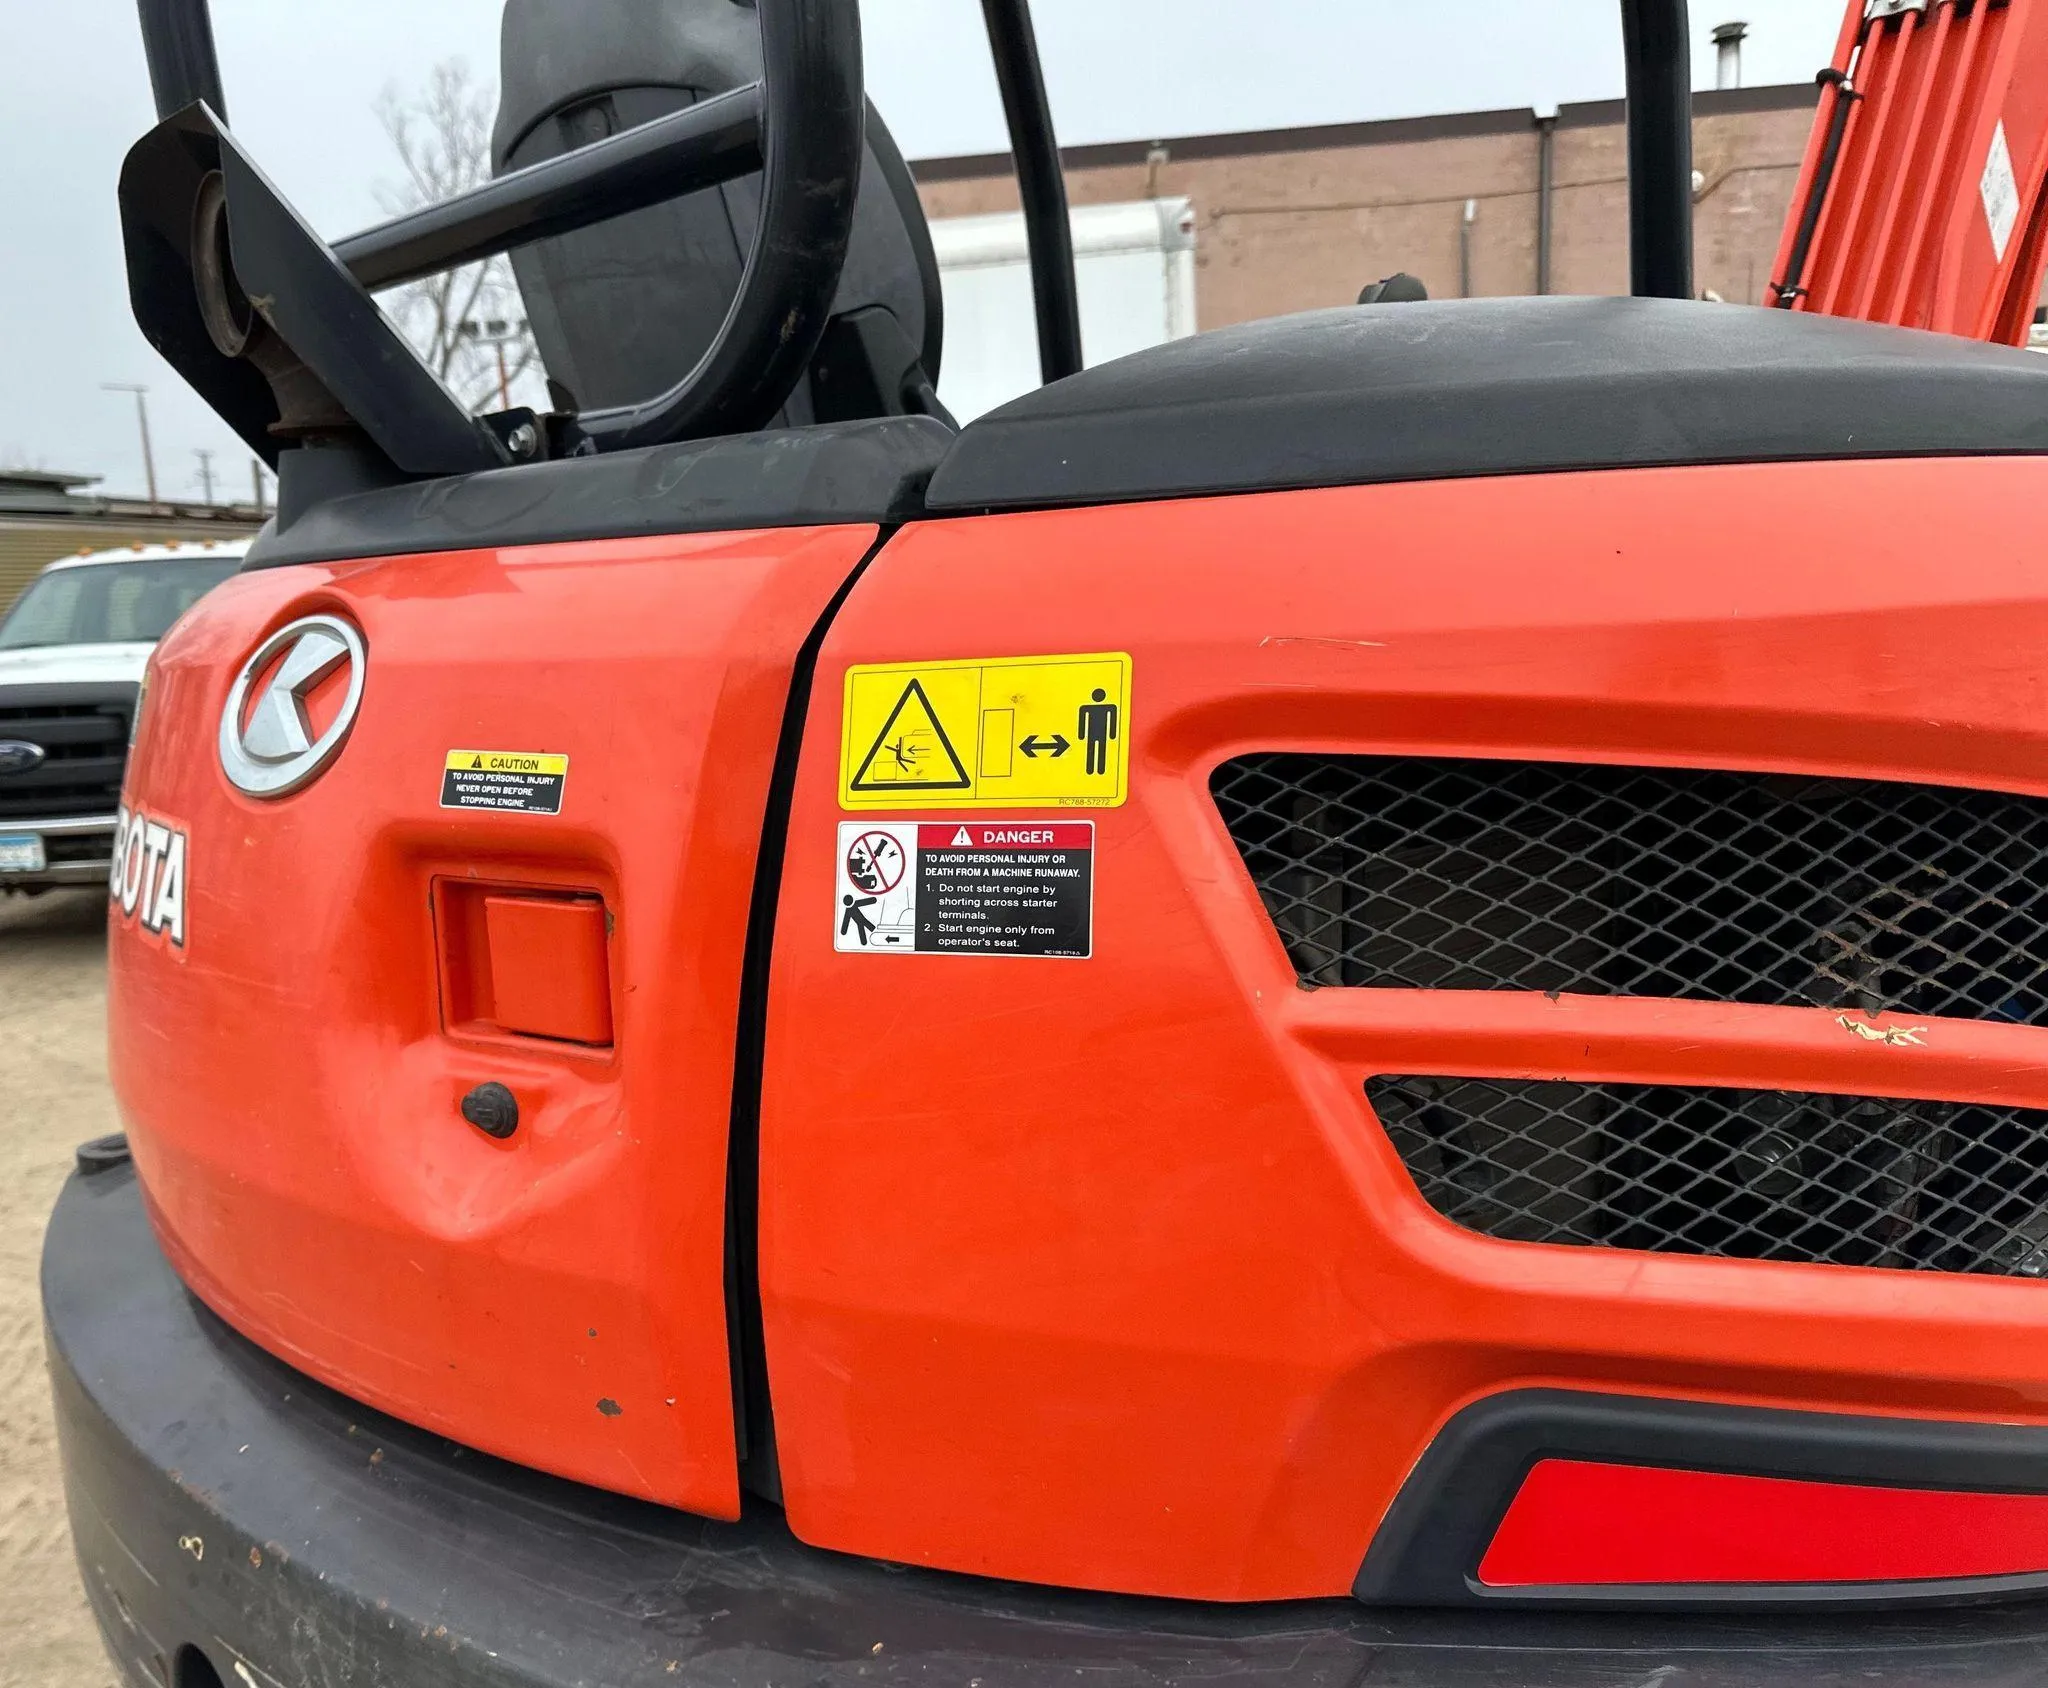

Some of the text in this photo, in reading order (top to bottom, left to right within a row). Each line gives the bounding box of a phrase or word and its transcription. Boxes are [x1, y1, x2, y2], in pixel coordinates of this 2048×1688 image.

[490, 757, 539, 770] CAUTION
[453, 772, 555, 785] TO AVOID PERSONAL INJURY
[456, 784, 533, 796] NEVER OPEN BEFORE
[460, 796, 525, 807] STOPPING ENGINE
[983, 831, 1054, 843] DANGER
[926, 855, 1066, 864] TO AVOID PERSONAL INJURY OR
[925, 868, 1081, 878] DEATH FROM A MACHINE RUNAWAY.
[926, 884, 1056, 896] 1. Do not start engine by
[939, 898, 1058, 908] shorting across starter
[938, 911, 990, 920] terminals.
[924, 924, 1055, 936] 2. Start engine only from
[938, 938, 1020, 948] operator's seat.
